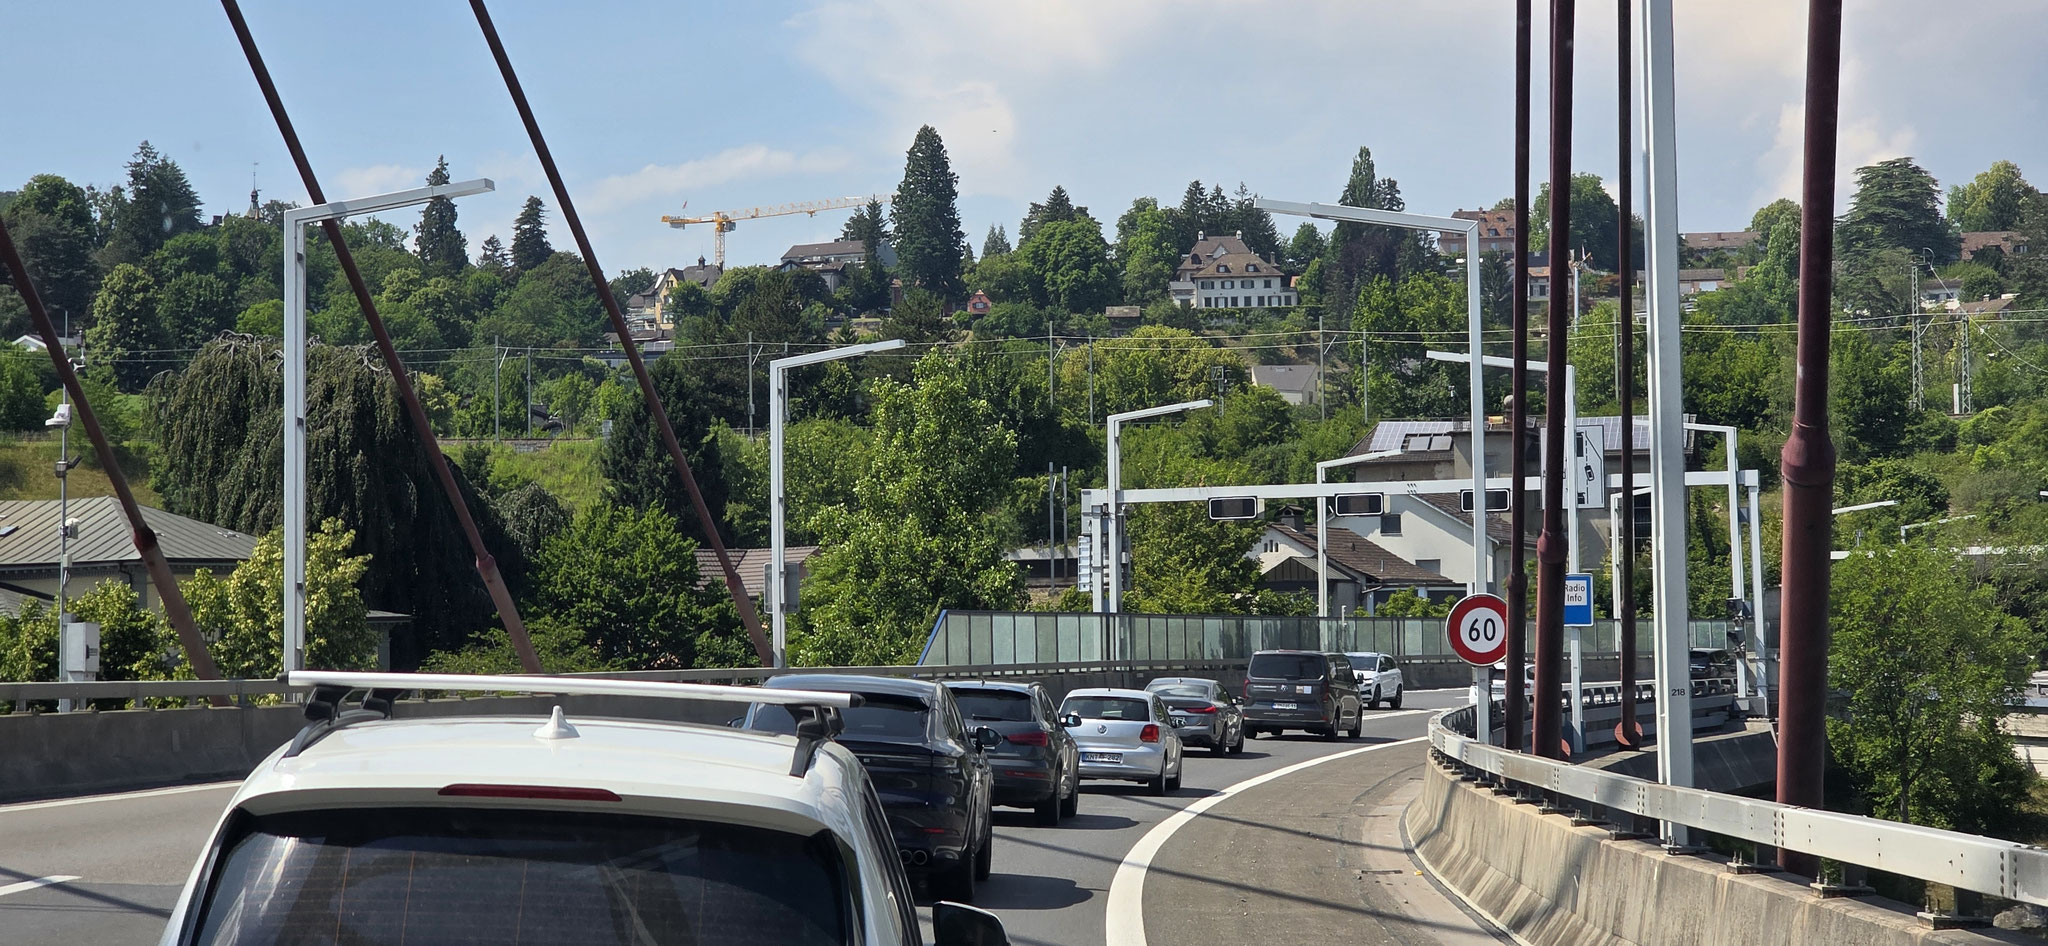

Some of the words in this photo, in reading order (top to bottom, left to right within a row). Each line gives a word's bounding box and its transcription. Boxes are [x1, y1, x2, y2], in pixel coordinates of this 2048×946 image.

[1564, 583, 1586, 592] Radio
[1567, 593, 1582, 602] Info
[1468, 618, 1496, 642] 60
[1671, 688, 1686, 696] 218
